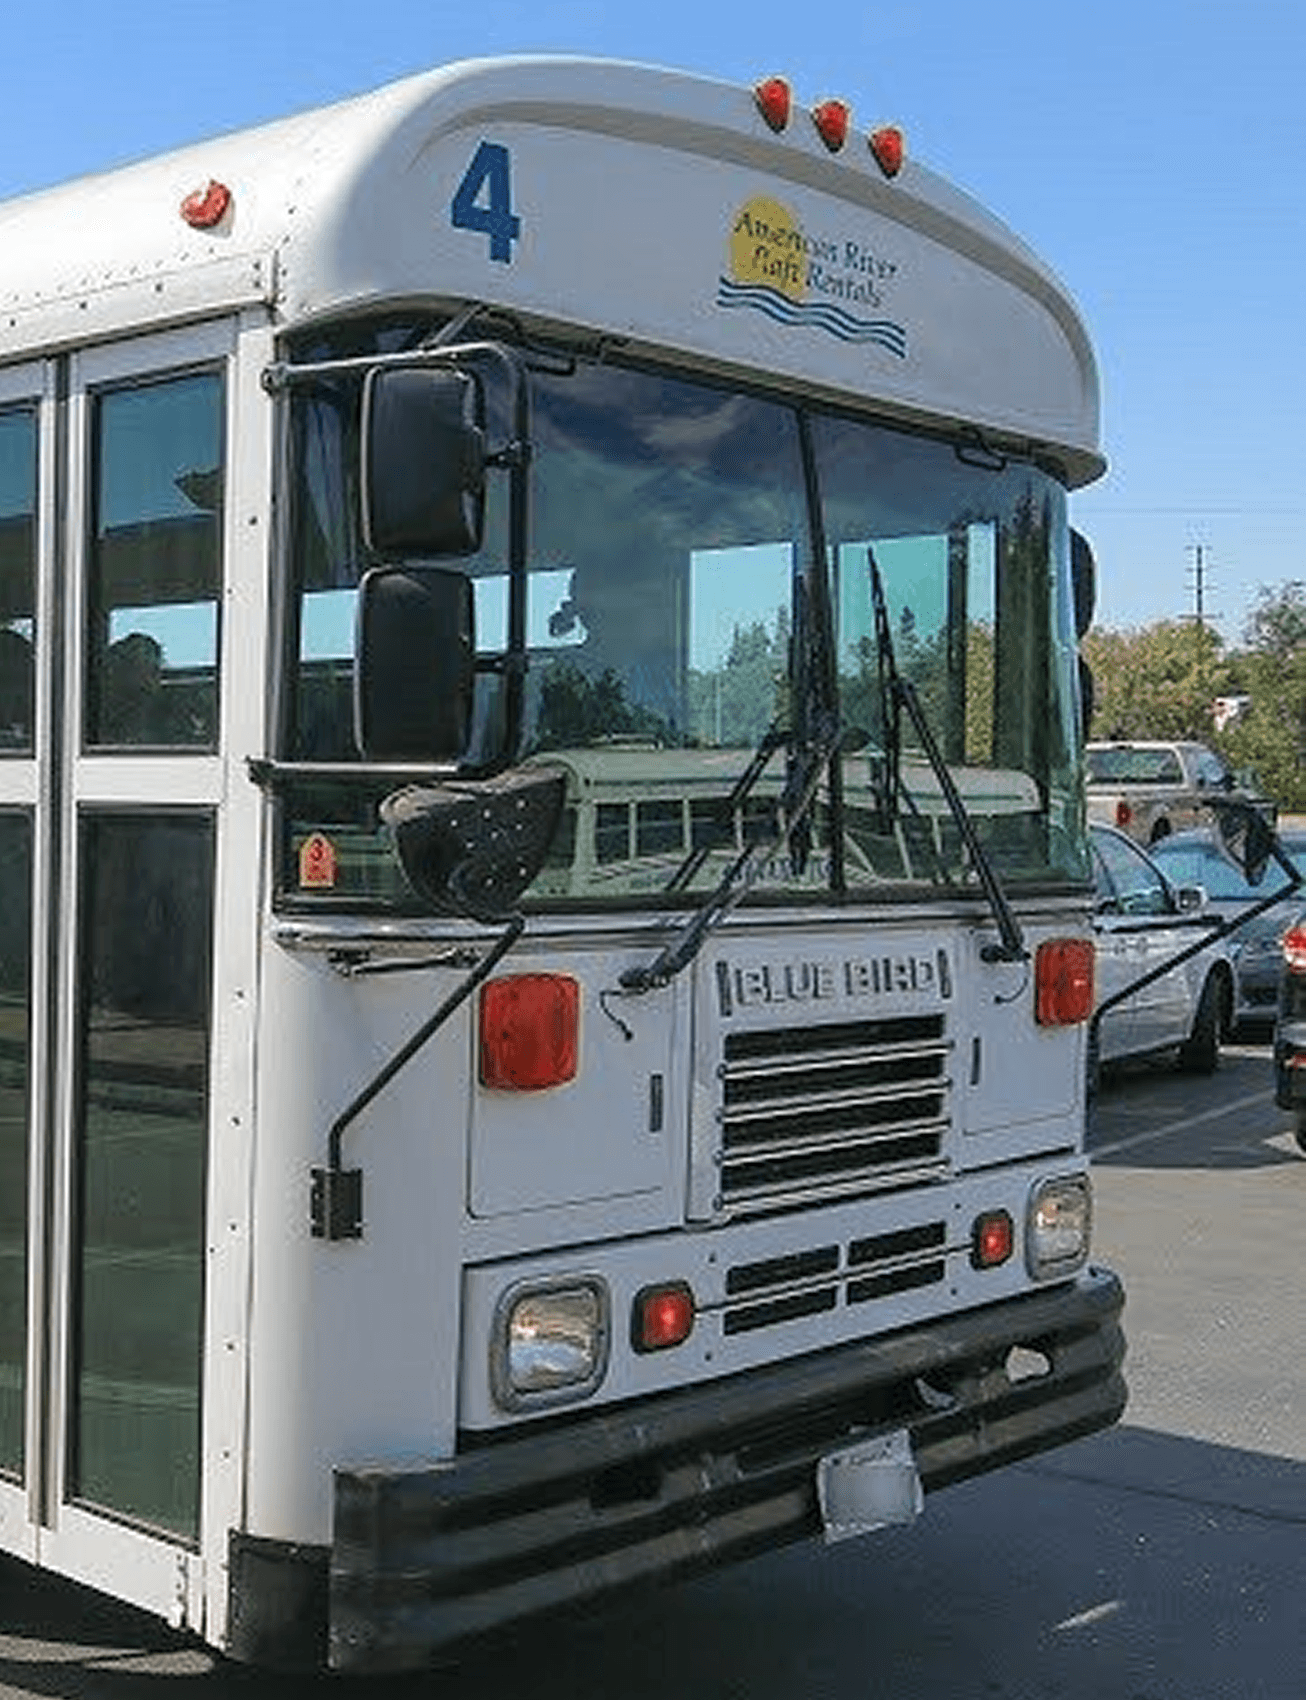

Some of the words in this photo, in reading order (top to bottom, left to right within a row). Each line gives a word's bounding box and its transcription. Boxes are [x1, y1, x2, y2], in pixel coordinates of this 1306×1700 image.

[451, 141, 520, 263] 4
[734, 963, 836, 1004] BLUE
[844, 957, 935, 996] BIRD
